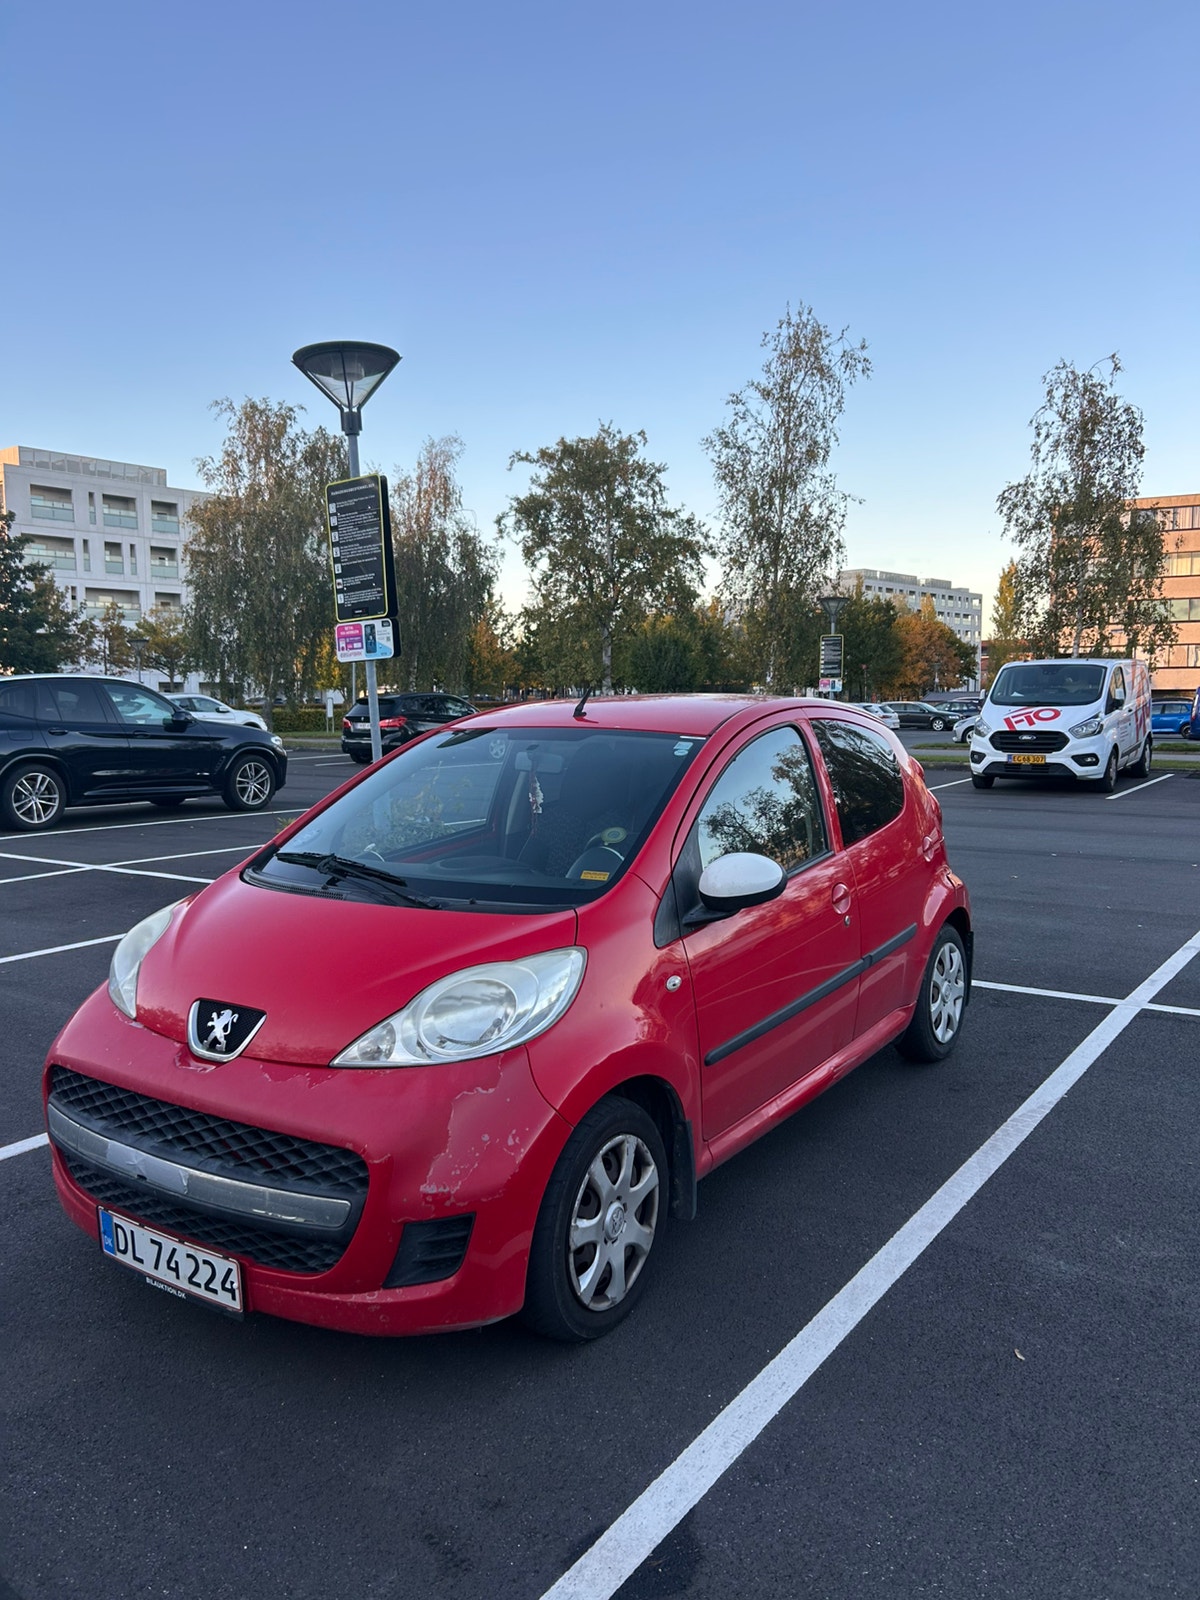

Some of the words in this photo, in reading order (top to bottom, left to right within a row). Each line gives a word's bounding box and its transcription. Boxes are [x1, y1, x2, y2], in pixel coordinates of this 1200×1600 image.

[104, 1235, 113, 1247] DK
[114, 1222, 144, 1265] DL
[145, 1276, 187, 1300] BILAUKTION.DK
